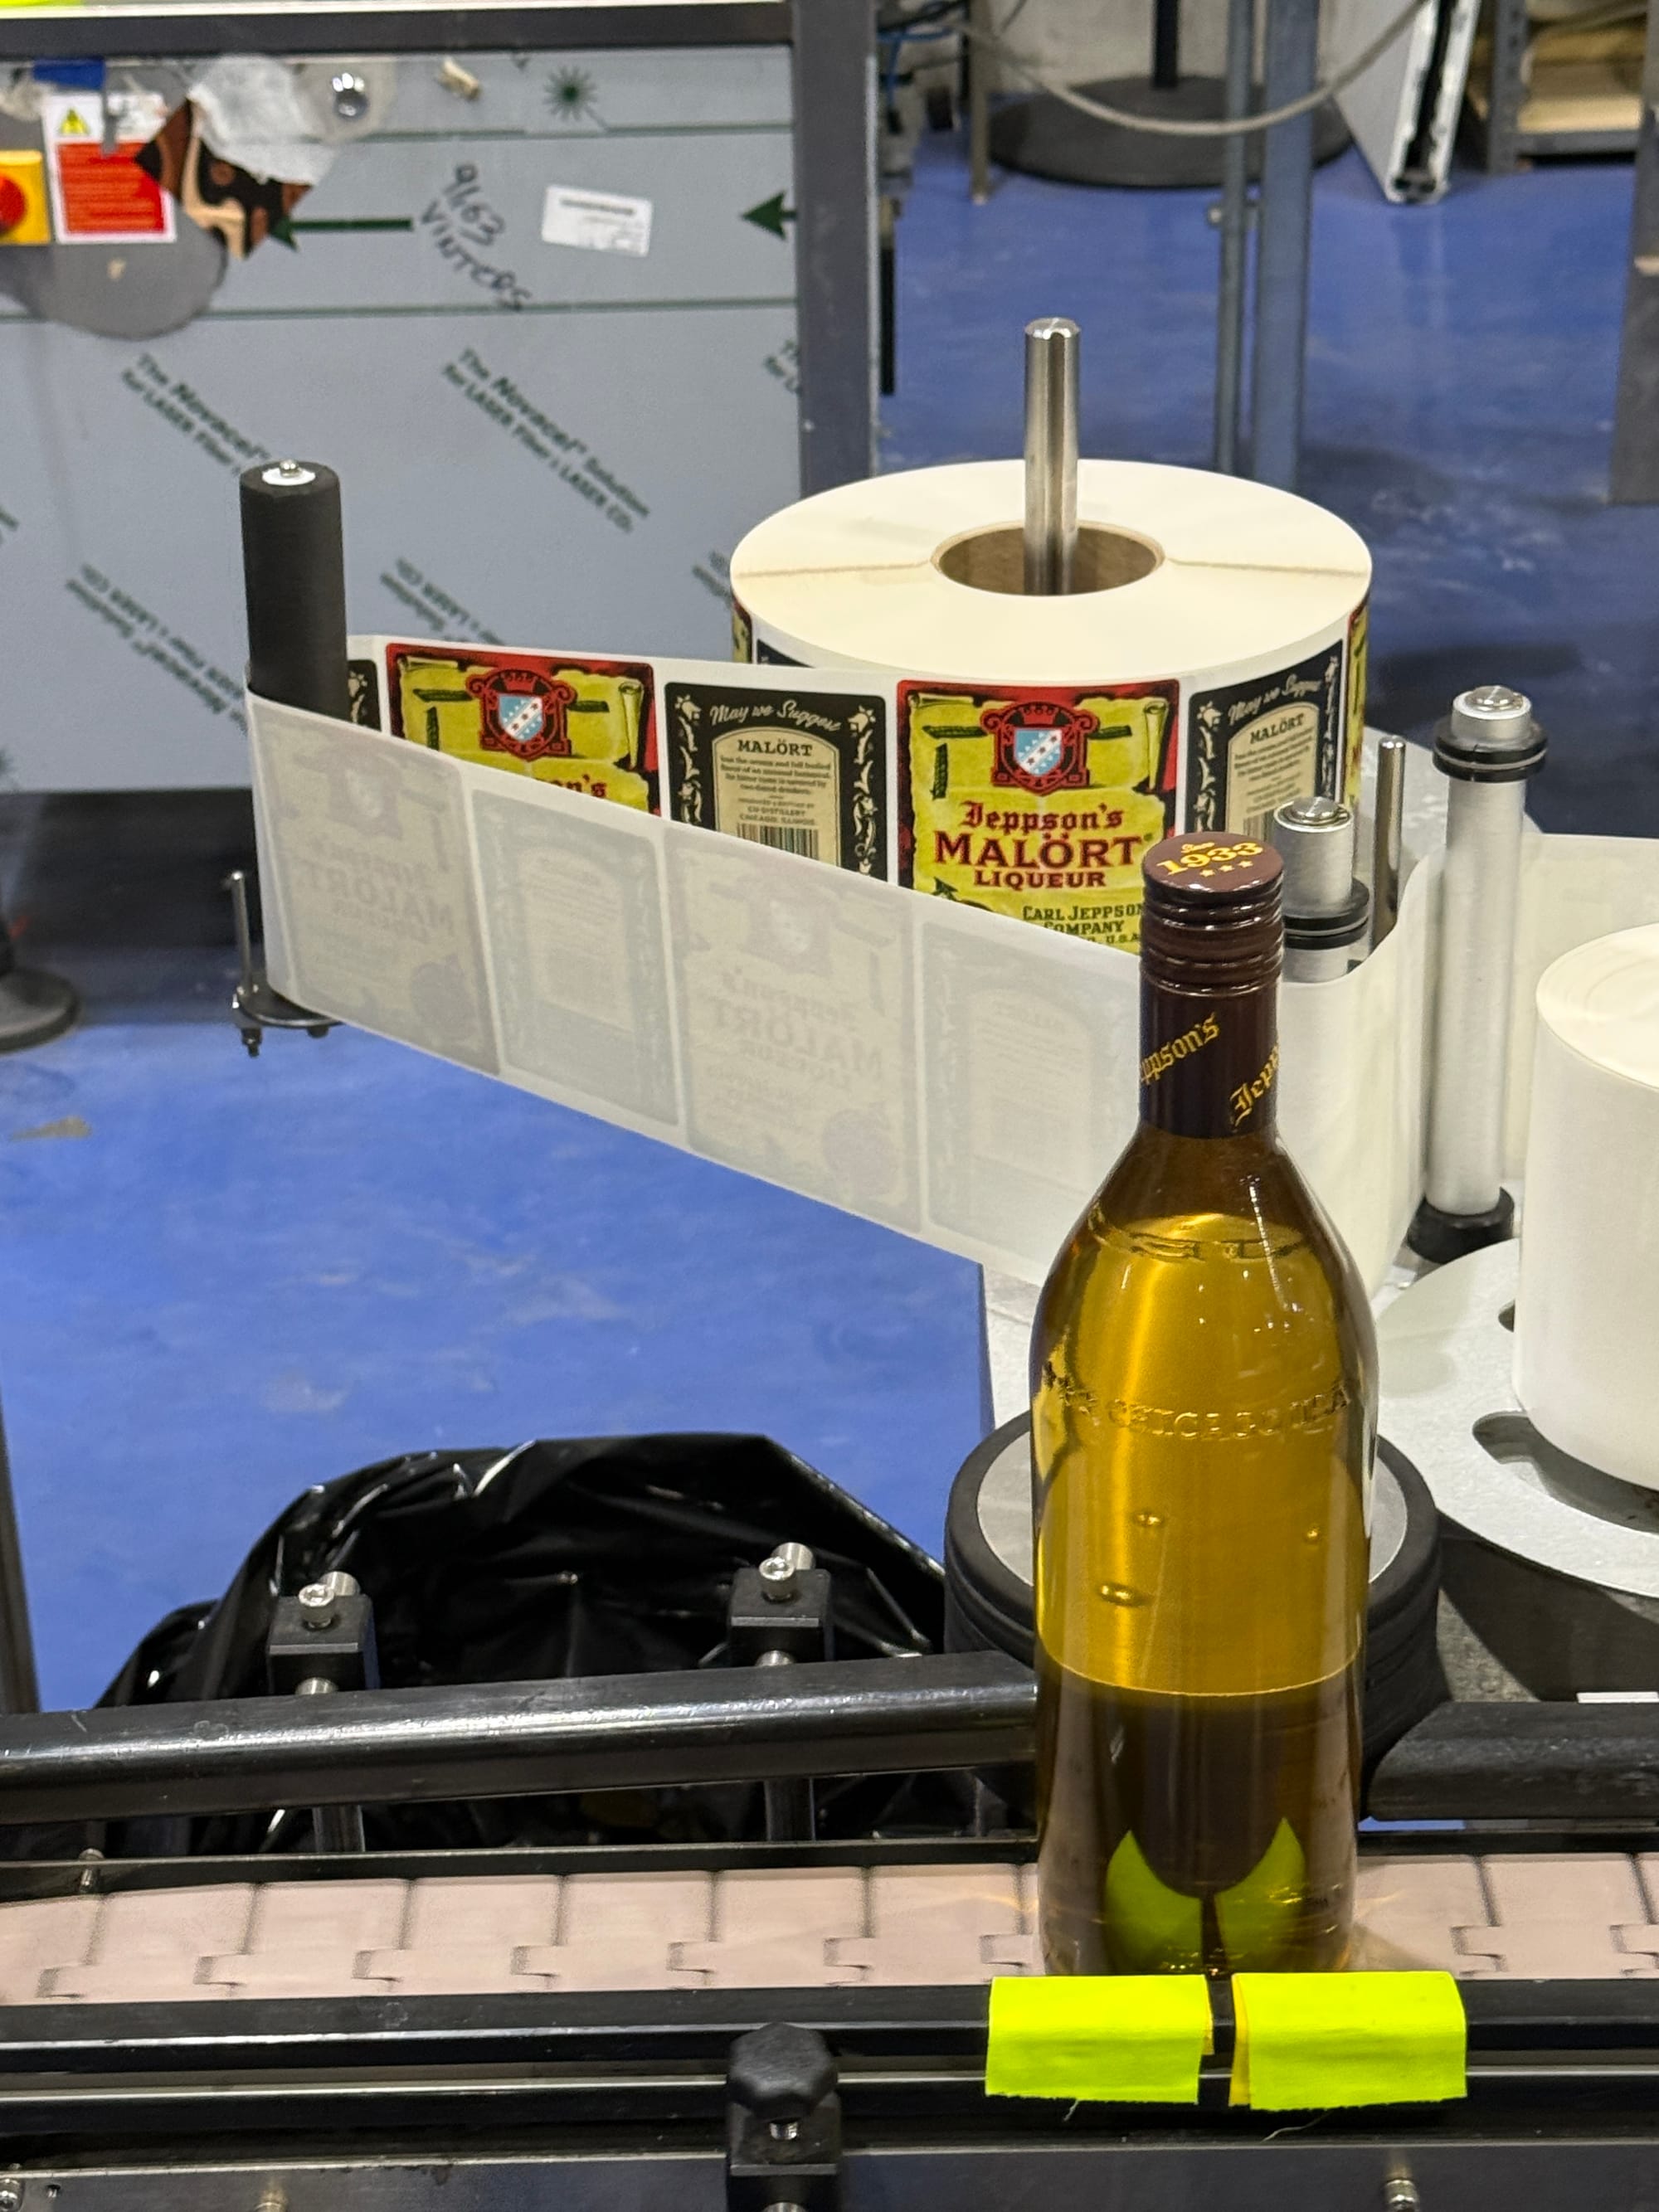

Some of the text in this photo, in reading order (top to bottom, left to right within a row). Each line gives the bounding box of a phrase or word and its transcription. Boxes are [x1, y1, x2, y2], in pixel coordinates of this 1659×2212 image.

[710, 705, 749, 726] May
[752, 705, 774, 717] we
[737, 738, 813, 756] MALÖRT
[958, 800, 1125, 837] Jeppson's
[934, 830, 1143, 868] MALÖRT
[1155, 842, 1264, 876] 1933
[974, 869, 1107, 891] LIQUEUR
[1023, 905, 1065, 921] CARL
